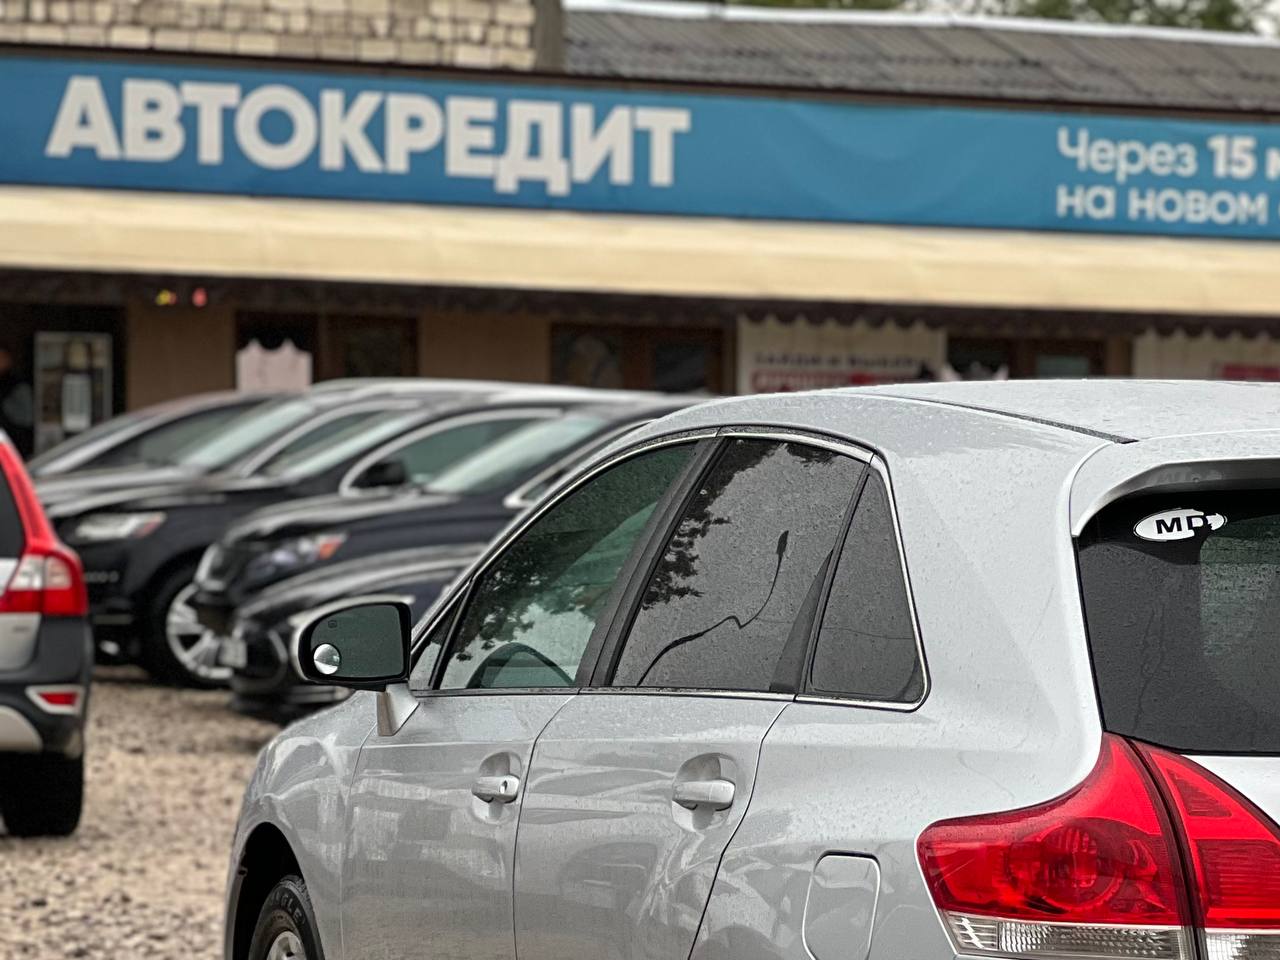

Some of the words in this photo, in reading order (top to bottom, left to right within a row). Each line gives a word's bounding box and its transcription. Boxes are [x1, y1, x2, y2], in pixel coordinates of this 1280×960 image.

[45, 75, 691, 196] АВТОКРЕДИТ
[1057, 127, 1198, 183] Через
[1207, 135, 1257, 179] 15
[1056, 184, 1116, 219] на
[1127, 188, 1268, 224] новом
[1155, 515, 1208, 534] MD
